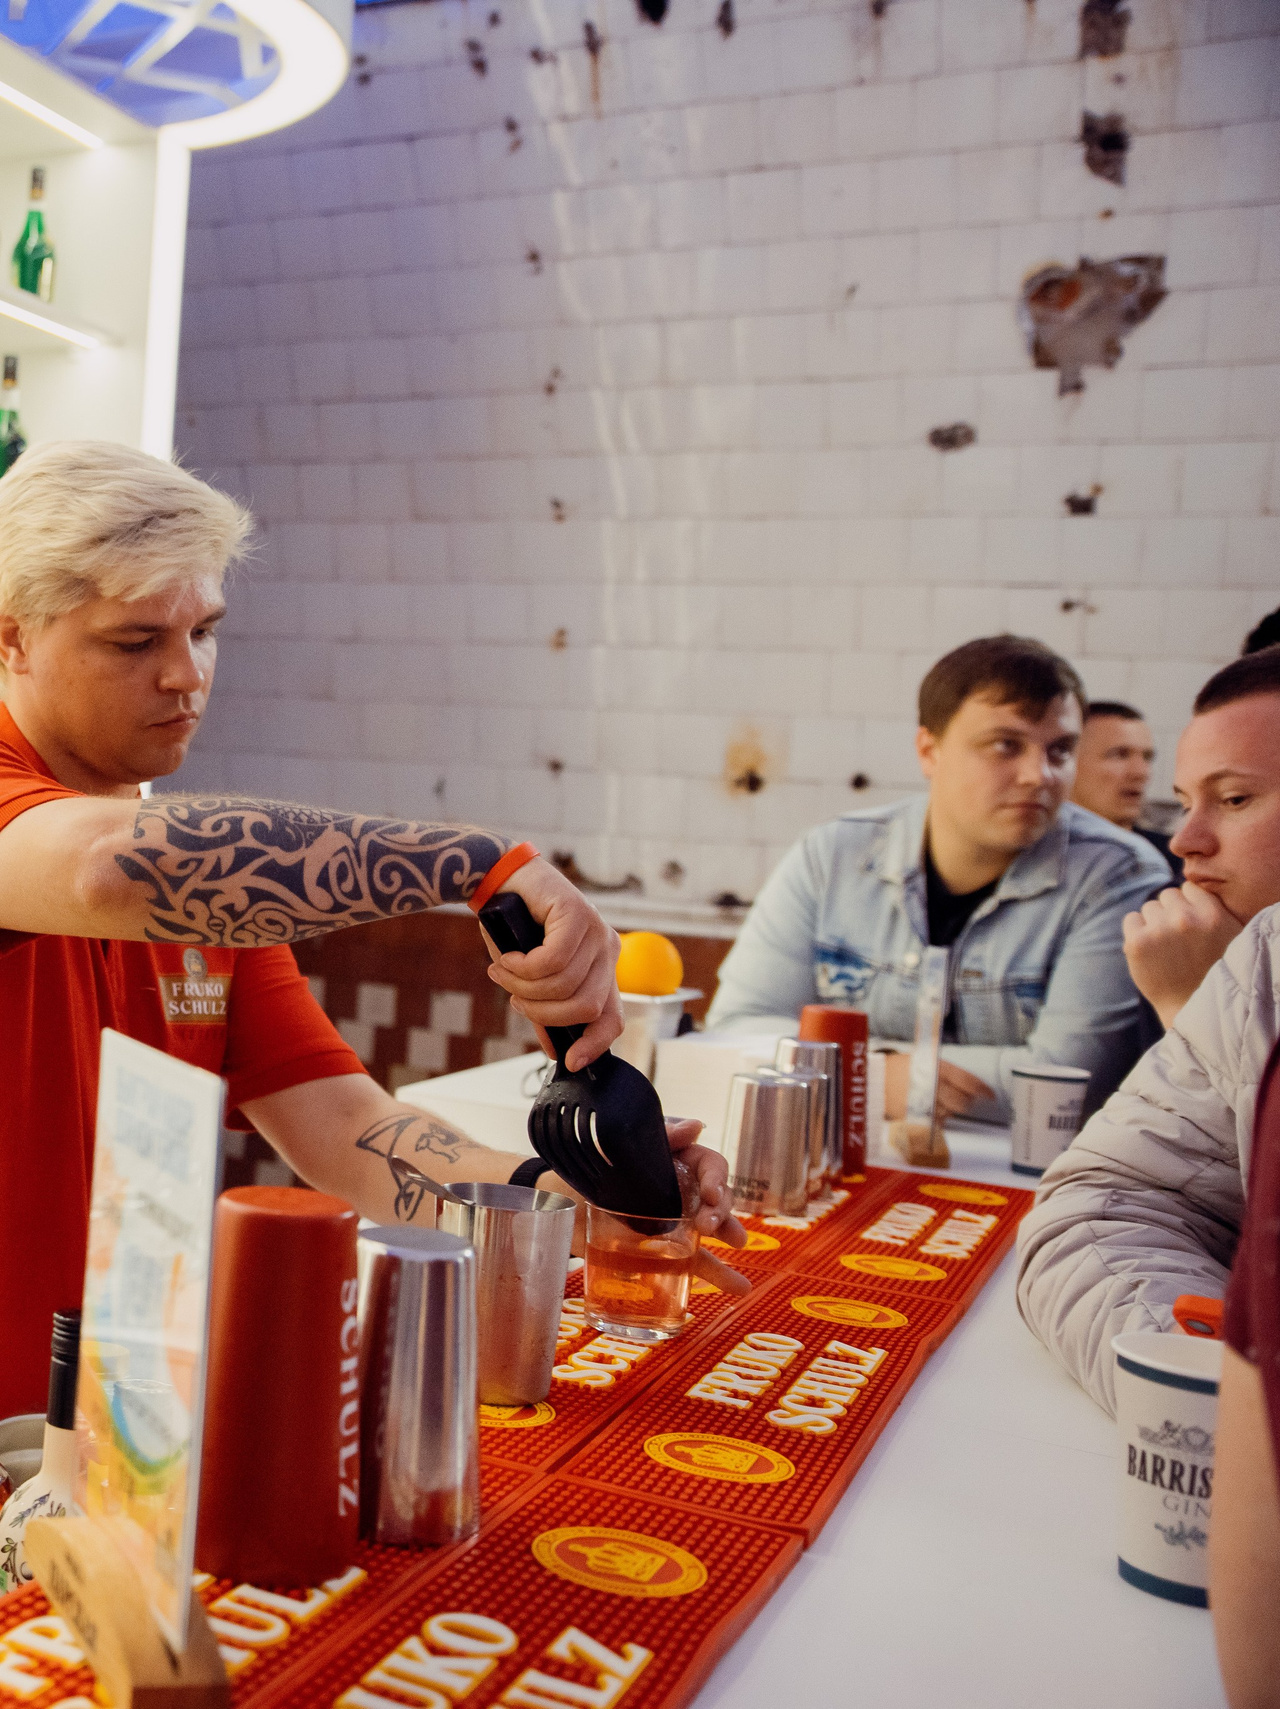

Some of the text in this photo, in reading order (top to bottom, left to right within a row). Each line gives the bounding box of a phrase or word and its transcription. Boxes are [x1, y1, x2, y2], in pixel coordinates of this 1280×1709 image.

[169, 1000, 226, 1015] SCHULZ
[172, 982, 224, 997] FRUKO
[848, 1041, 865, 1149] SCHULZ
[337, 1277, 360, 1518] SCHULZ
[685, 1331, 805, 1409] FRUKO
[765, 1339, 889, 1435] SCHULZ
